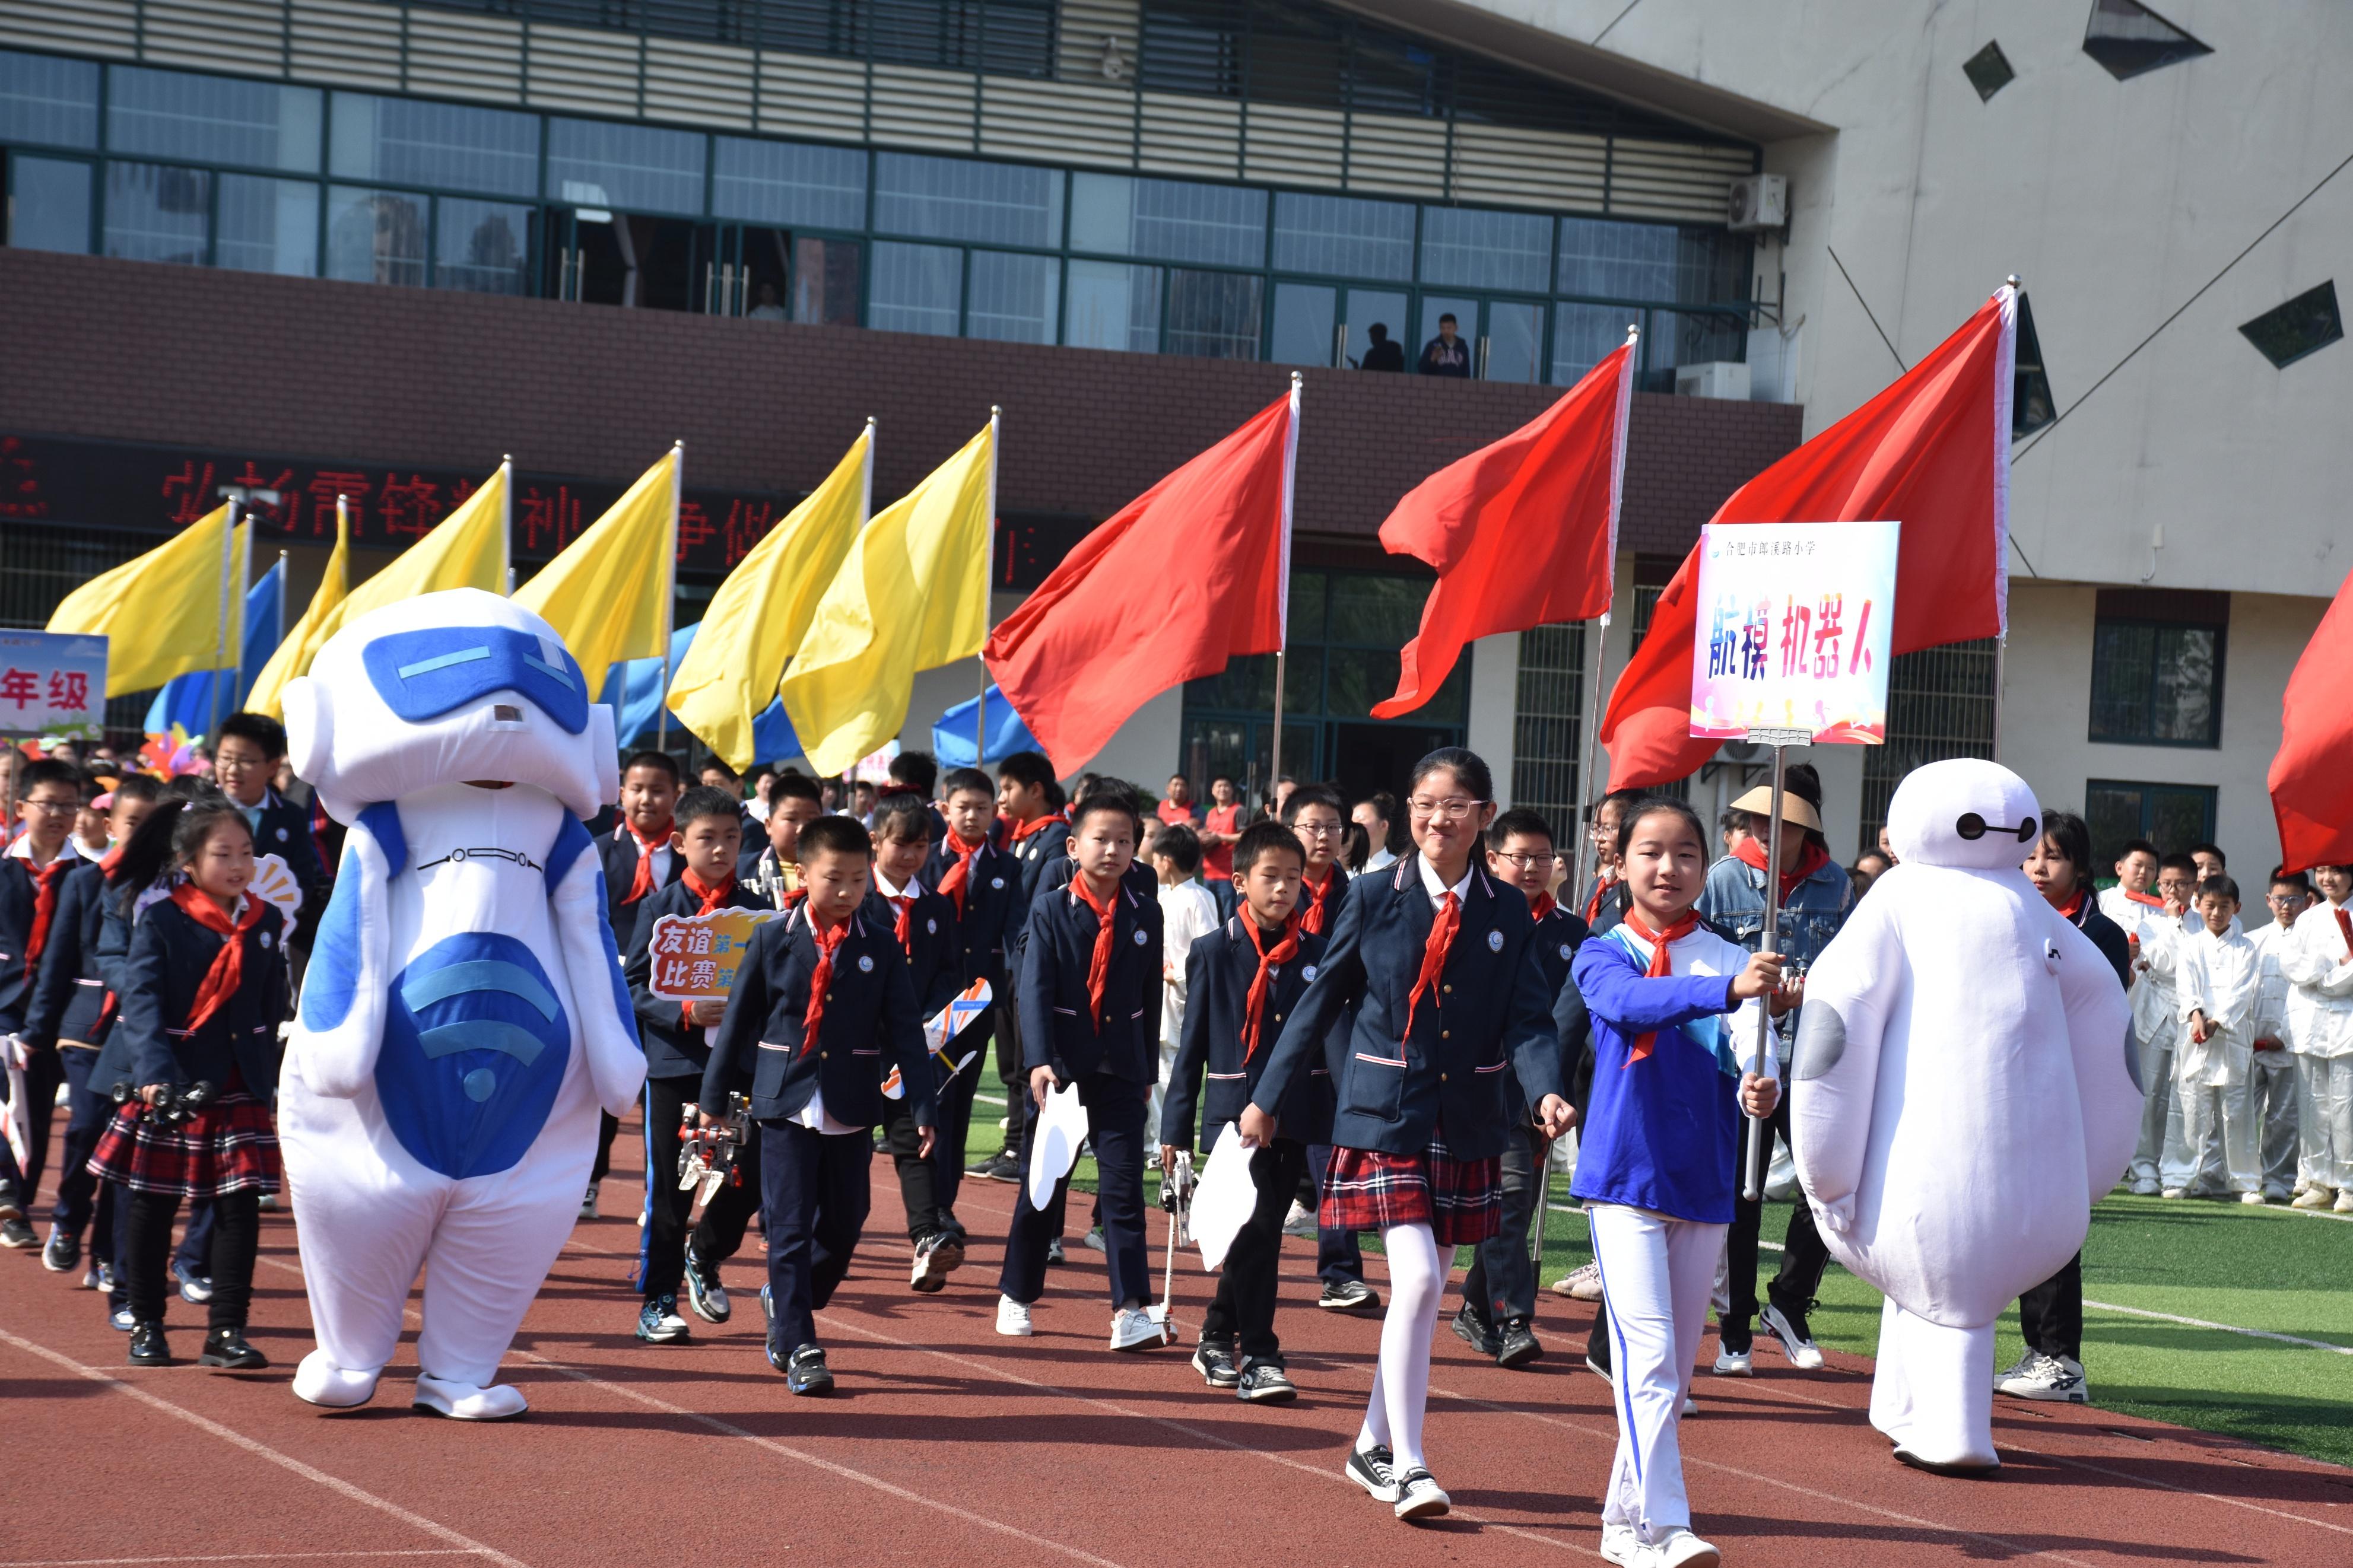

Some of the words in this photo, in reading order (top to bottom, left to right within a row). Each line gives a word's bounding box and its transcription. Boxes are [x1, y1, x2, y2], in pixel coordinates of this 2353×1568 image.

[1726, 540, 1815, 556] 合肥市郎溪路小学
[1708, 592, 1873, 681] 航模机器人
[1, 667, 88, 710] 年级
